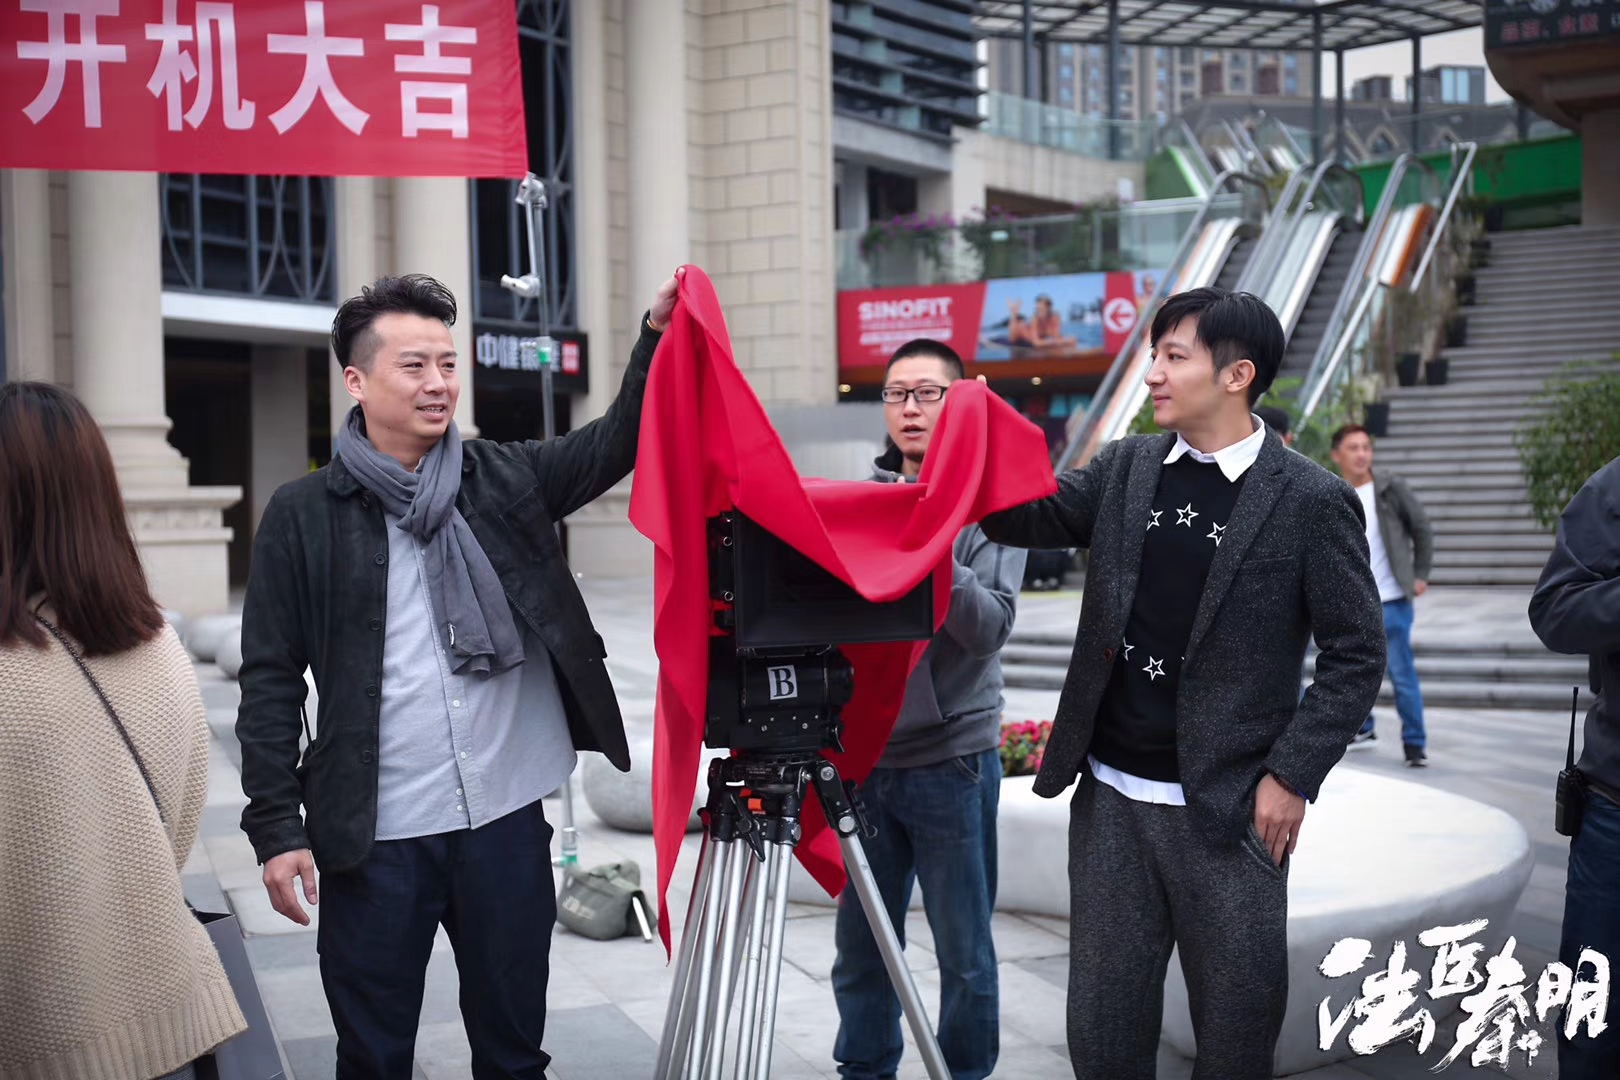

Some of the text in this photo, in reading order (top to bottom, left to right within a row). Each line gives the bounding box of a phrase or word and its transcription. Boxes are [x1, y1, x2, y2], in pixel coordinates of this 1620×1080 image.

[16, 0, 478, 138] 开机大吉
[858, 296, 953, 321] SINOFIT
[770, 667, 795, 697] B
